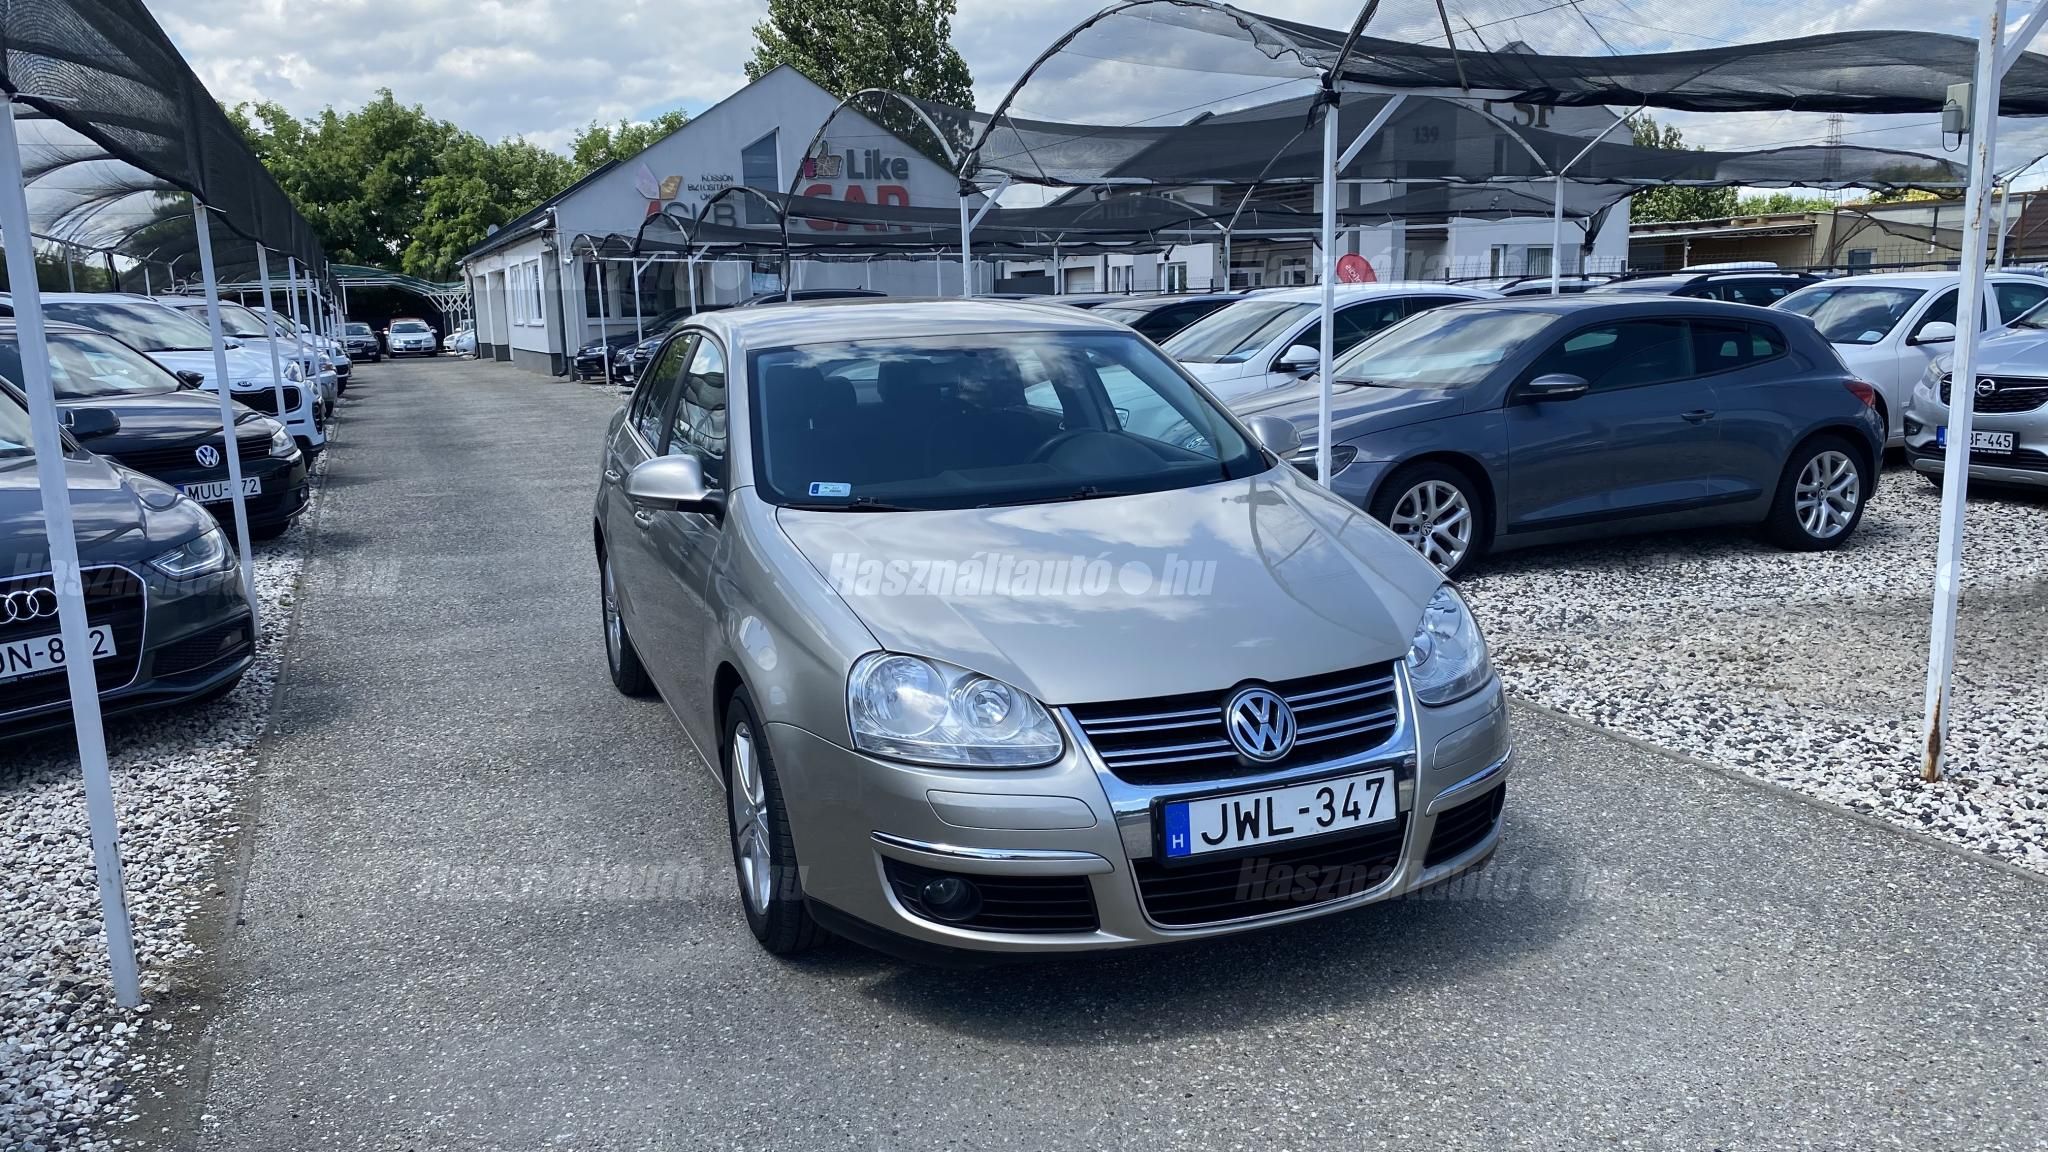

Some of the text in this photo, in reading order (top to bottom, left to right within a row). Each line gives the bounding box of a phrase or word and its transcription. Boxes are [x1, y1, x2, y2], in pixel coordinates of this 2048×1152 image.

[846, 148, 909, 180] Like
[188, 478, 258, 501] MUU-72
[0, 629, 108, 675] N-82
[1172, 776, 1385, 848] H JWL-347
